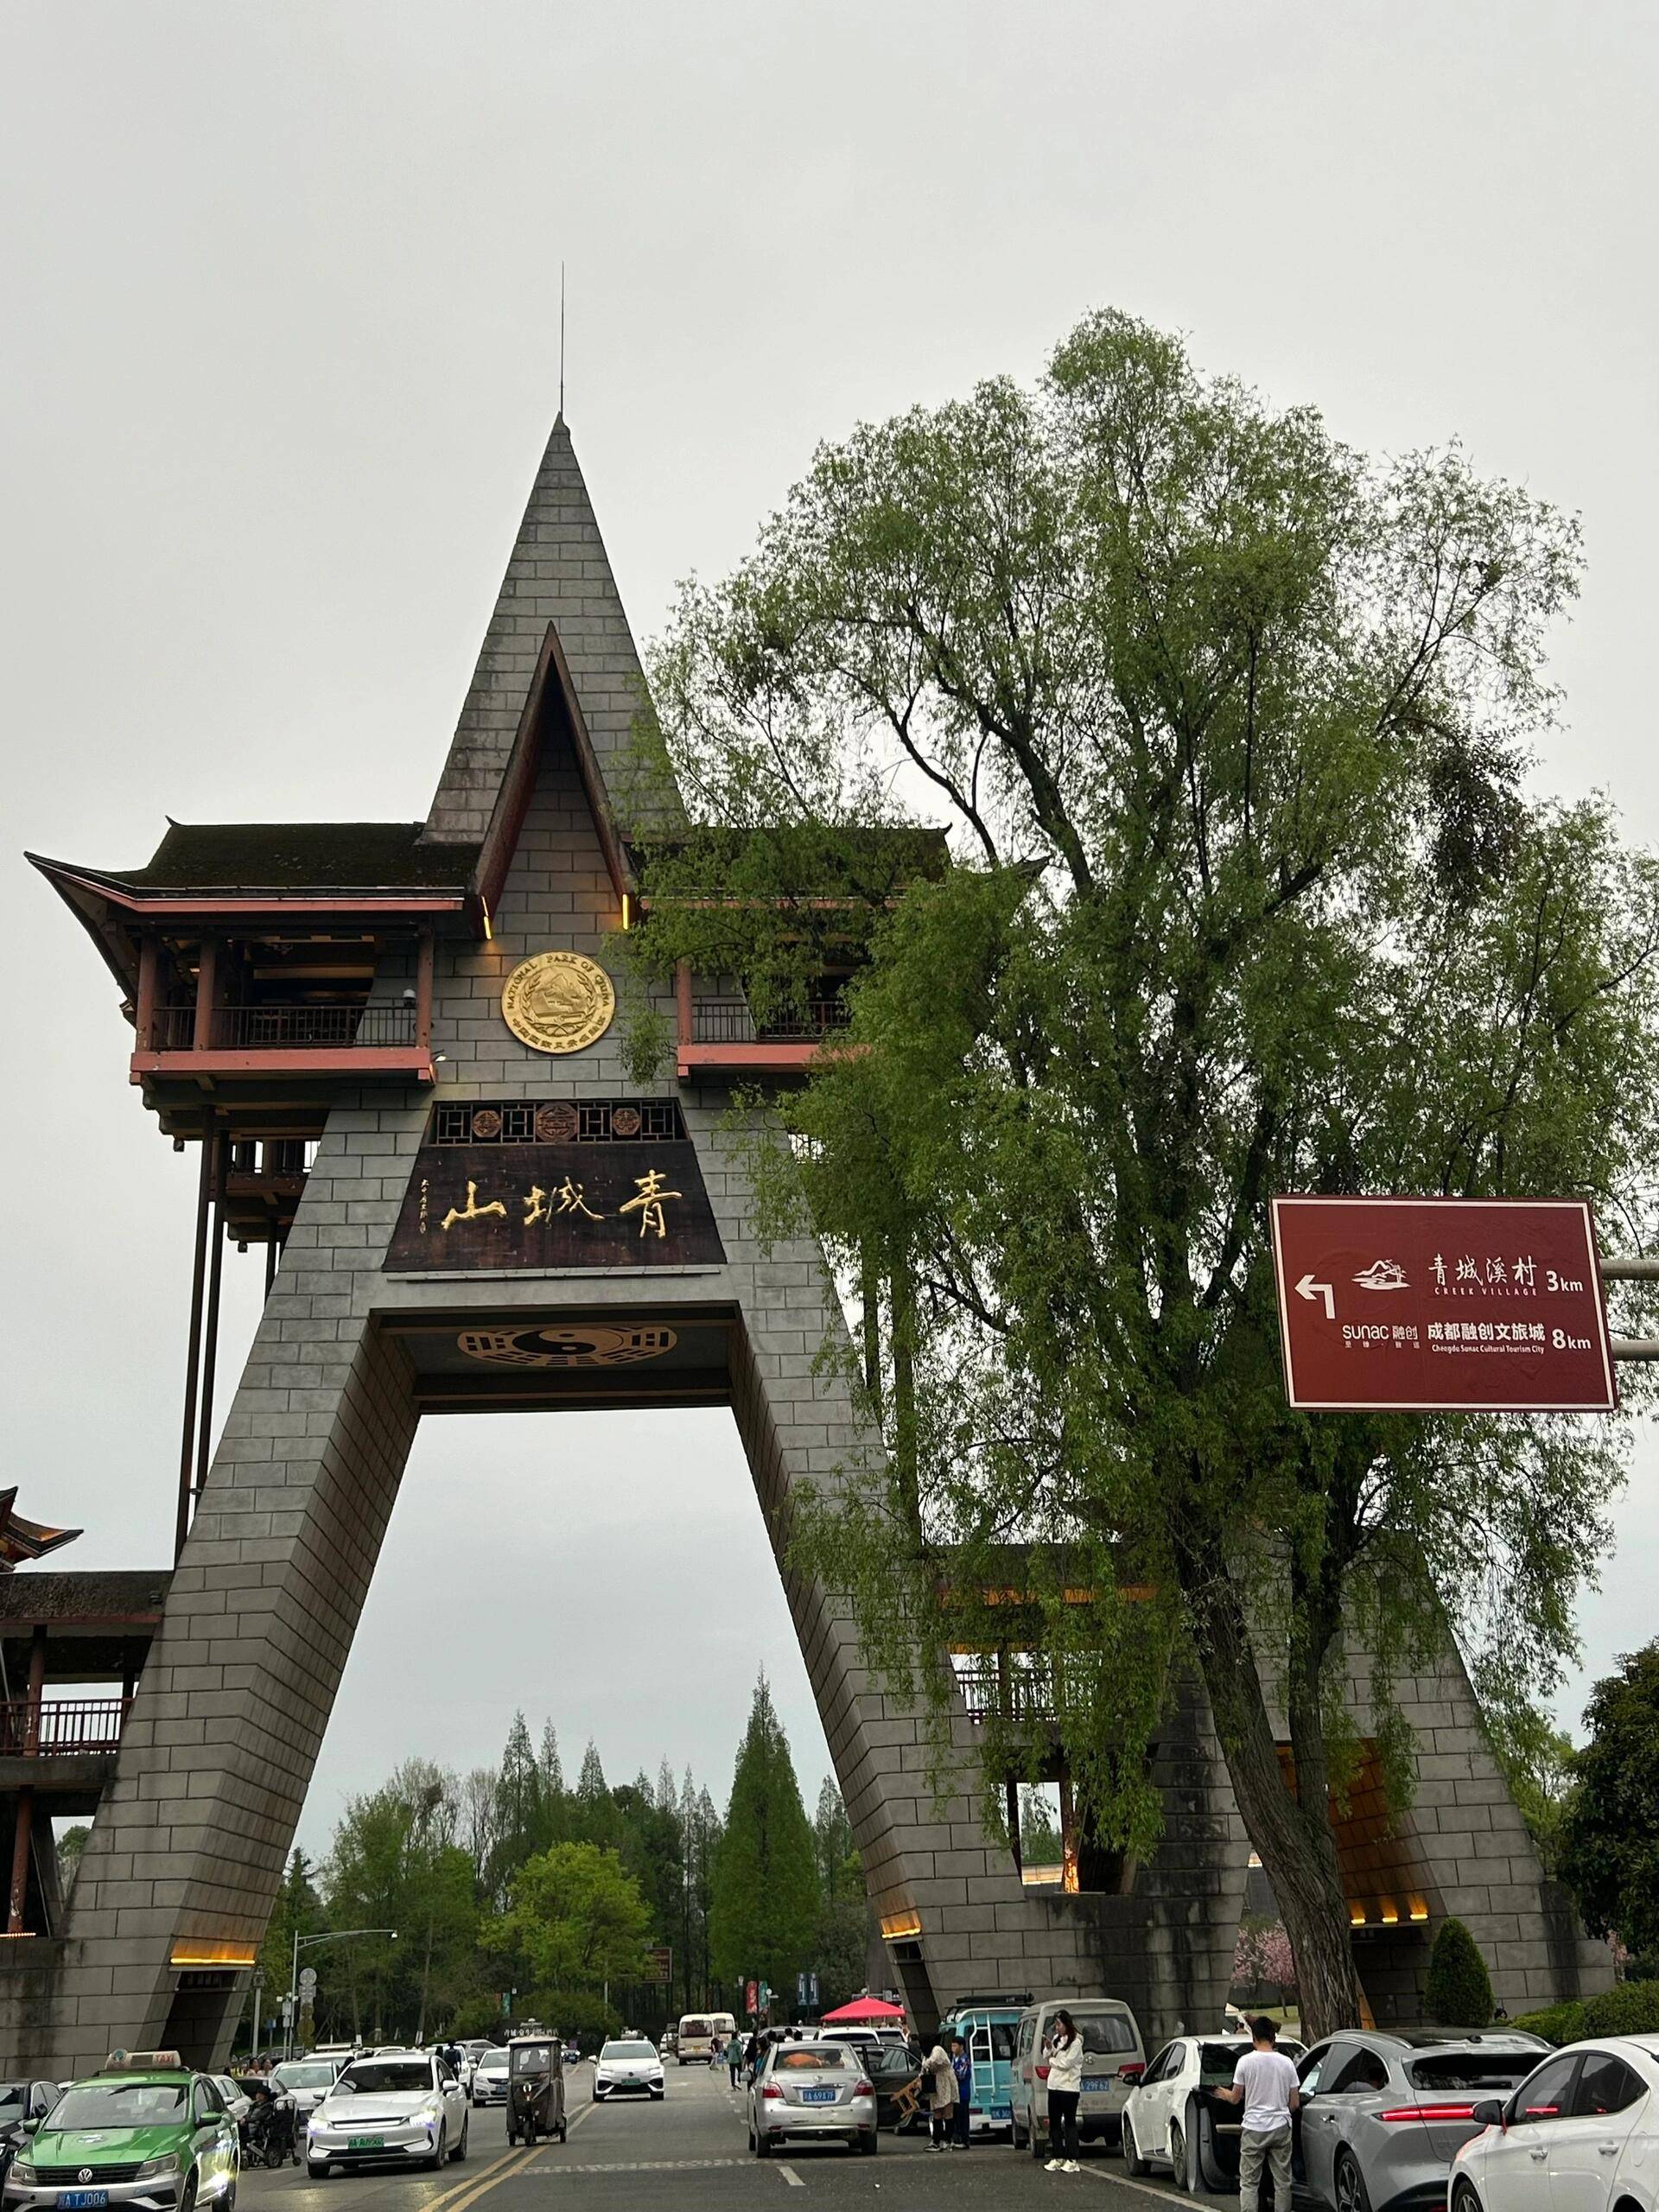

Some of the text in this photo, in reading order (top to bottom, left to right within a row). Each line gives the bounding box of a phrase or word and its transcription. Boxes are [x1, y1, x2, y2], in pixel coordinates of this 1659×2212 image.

[507, 954, 610, 1009] NATIONAL PARK OF CHINA
[442, 1169, 682, 1238] 青城山
[1427, 1253, 1537, 1287] 青城溪村
[1434, 1287, 1537, 1297] CREEK VILLAGE
[1392, 1325, 1419, 1340] 融创
[1427, 1322, 1546, 1341] 成都融创文旅城
[1432, 1344, 1460, 1354] Chengdu
[1480, 1344, 1505, 1353] Cultural
[1506, 1344, 1531, 1353] Tourism
[1531, 1344, 1545, 1355] City
